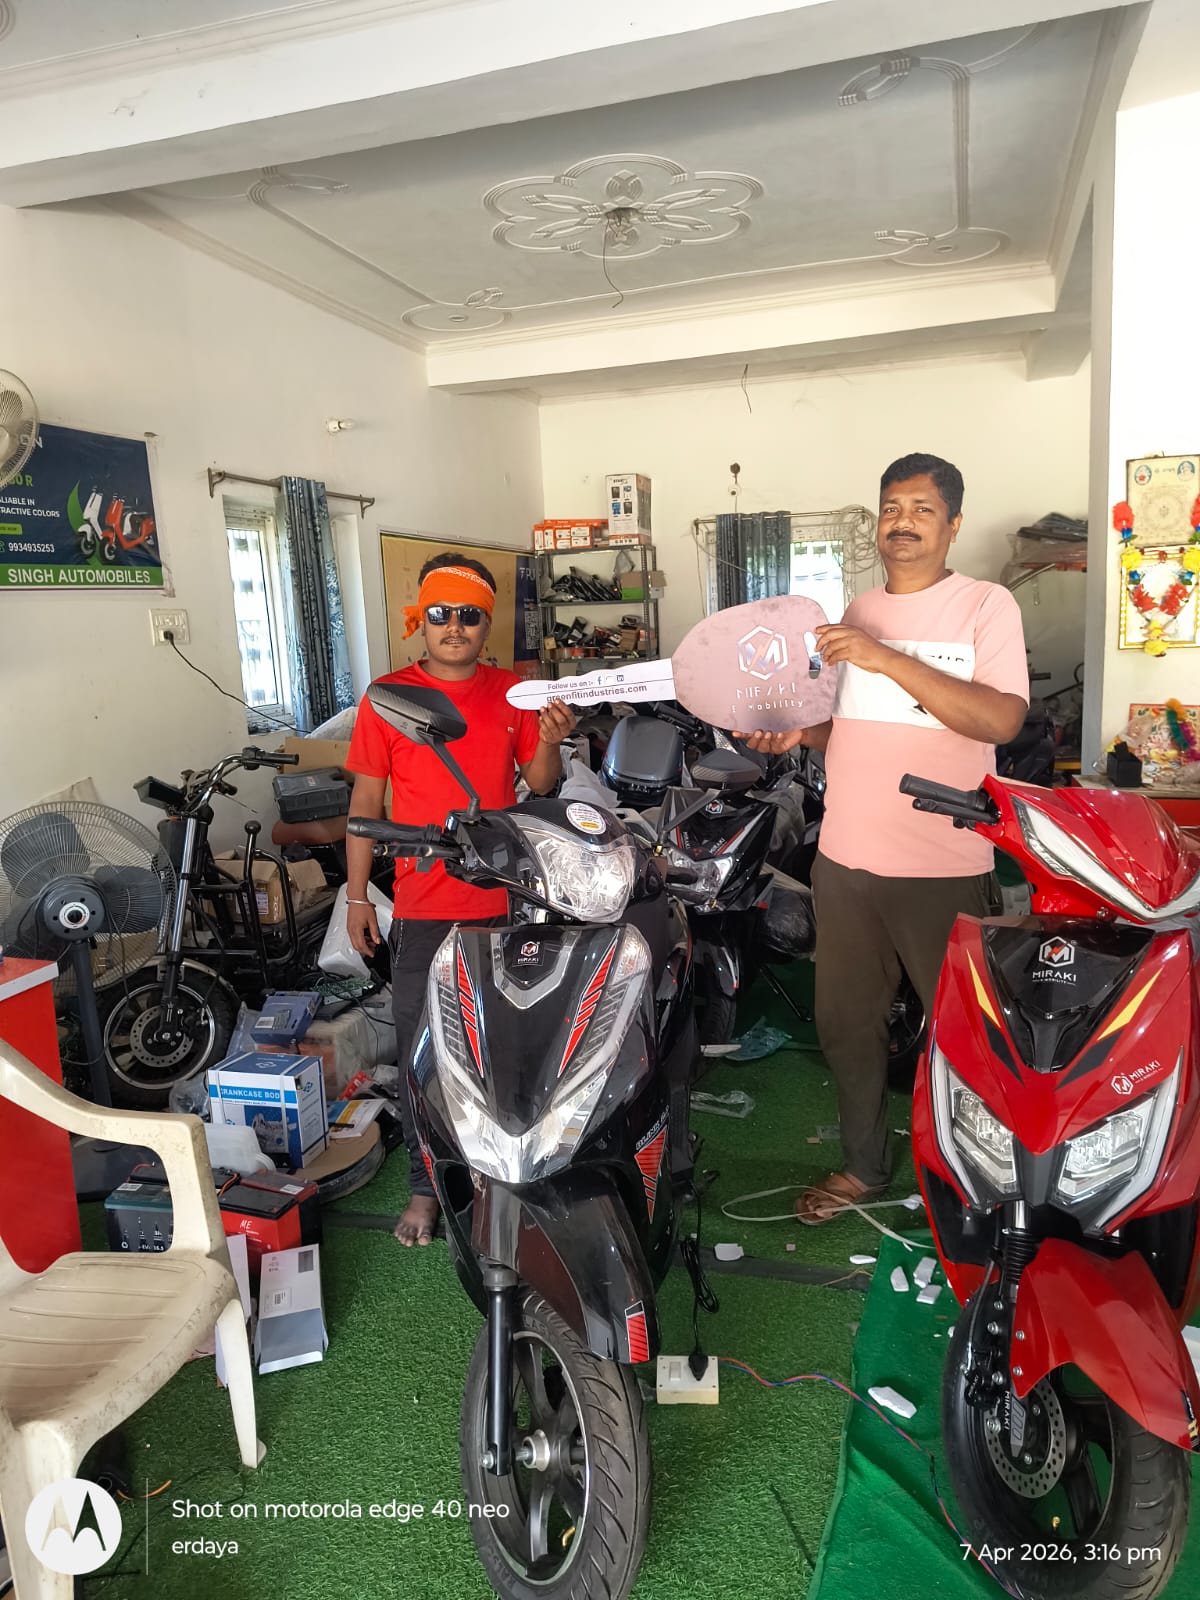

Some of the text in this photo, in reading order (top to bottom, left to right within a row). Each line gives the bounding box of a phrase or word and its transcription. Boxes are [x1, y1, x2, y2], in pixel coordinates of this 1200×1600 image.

[27, 498, 36, 506] IN
[32, 509, 60, 517] COLORS
[8, 542, 55, 553] 9934935253
[8, 568, 151, 584] SINGH AUTOMOBILES
[547, 683, 569, 691] Follow
[546, 685, 648, 702] greenfitindustries.com
[1032, 969, 1077, 982] MIRAKI
[1129, 1060, 1161, 1080] MIRAKI
